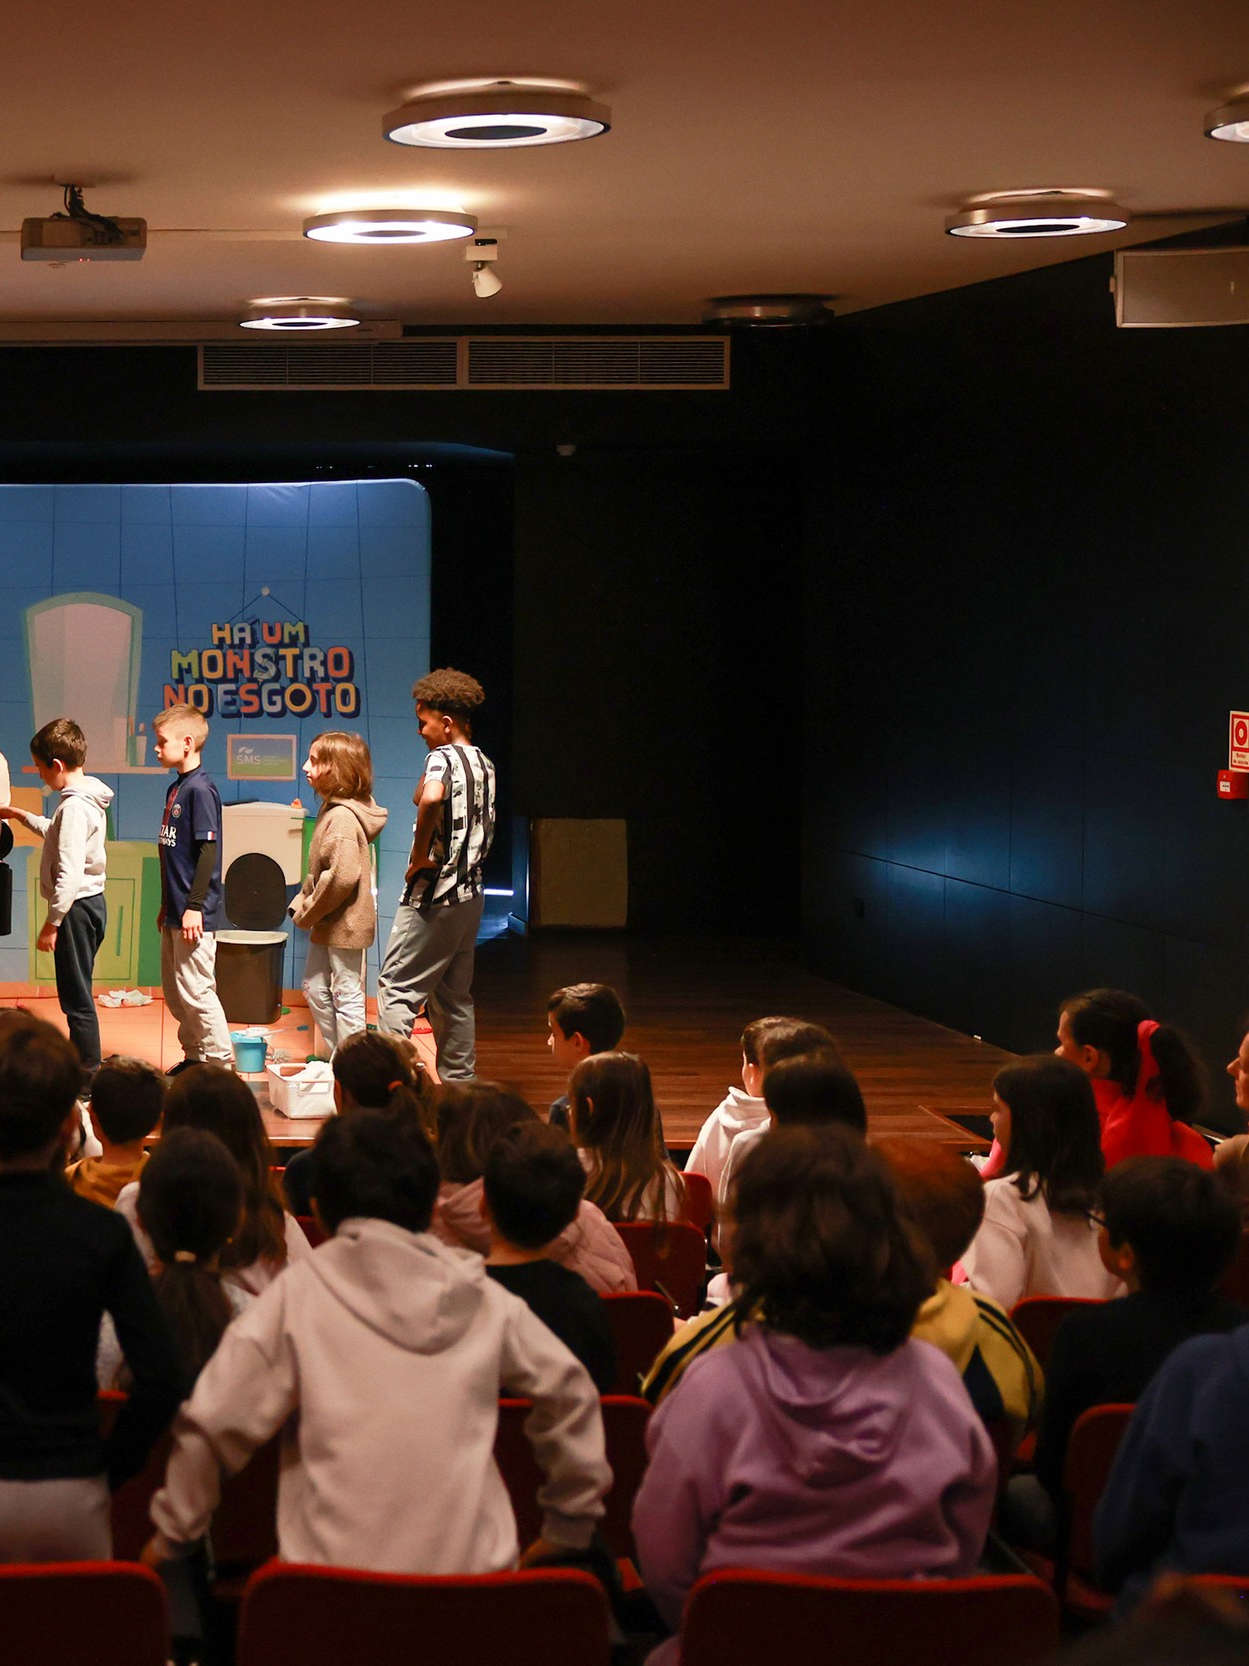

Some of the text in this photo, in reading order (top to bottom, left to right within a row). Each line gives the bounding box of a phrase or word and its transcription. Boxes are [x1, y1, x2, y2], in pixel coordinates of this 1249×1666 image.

[261, 621, 307, 646] UM
[171, 646, 353, 681] MONSTRO
[163, 682, 358, 716] NO ESGOTO
[236, 755, 261, 766] SMS
